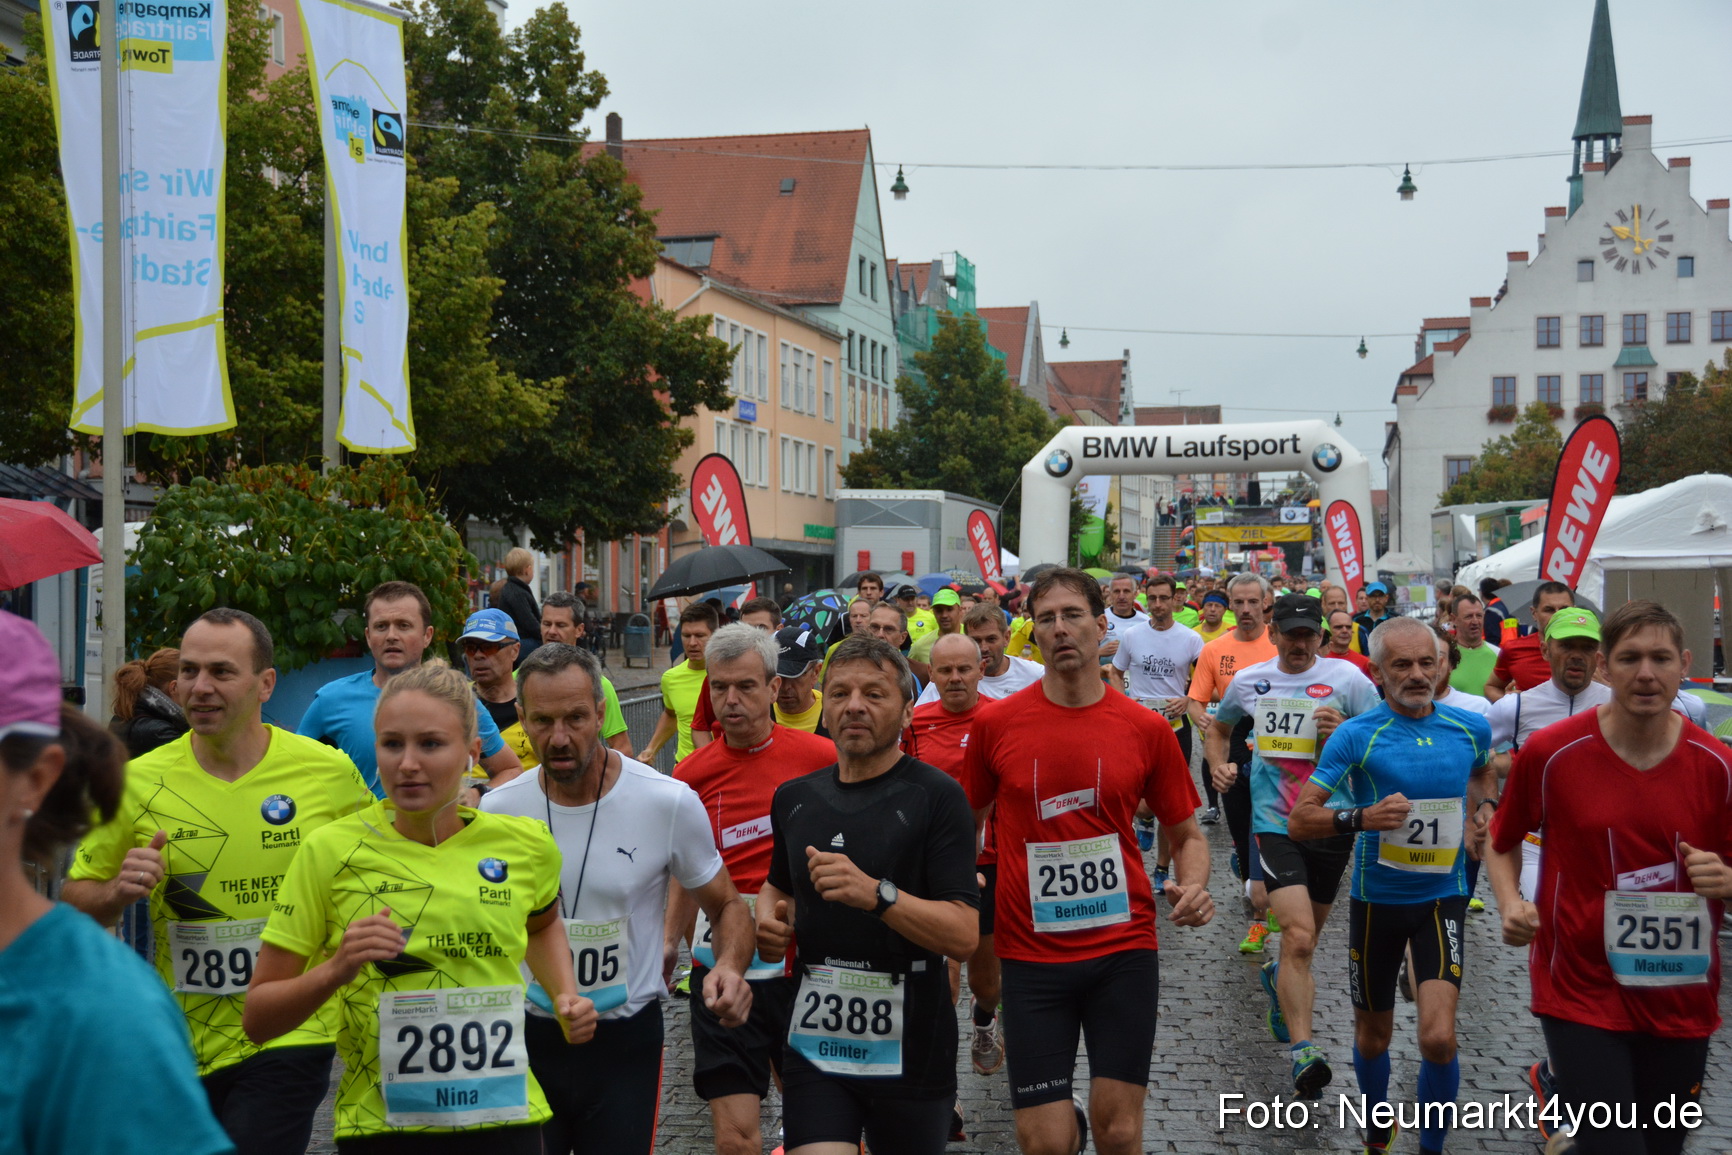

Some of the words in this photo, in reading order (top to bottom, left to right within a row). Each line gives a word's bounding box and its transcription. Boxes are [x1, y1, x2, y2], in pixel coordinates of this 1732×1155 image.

[1083, 436, 1158, 458] BMW
[1166, 433, 1301, 461] Laufsport
[1547, 440, 1610, 583] REWE
[1241, 529, 1267, 539] ZIEL
[1265, 711, 1305, 735] 347
[1272, 739, 1293, 751] Sepp
[1056, 796, 1080, 809] DEHN
[1420, 801, 1457, 812] BOCK
[261, 827, 300, 843] Partl
[736, 824, 759, 839] DEHN
[1407, 818, 1439, 845] 21
[262, 840, 301, 850] Neumarkt
[1067, 838, 1112, 855] BOCK
[1409, 851, 1435, 863] Willi
[1039, 857, 1118, 897] 2588
[1634, 871, 1660, 885] DEHN
[220, 879, 248, 892] THE
[479, 886, 511, 900] Partl
[234, 891, 259, 904] 100
[1055, 901, 1107, 919] Berthold
[569, 921, 619, 938] BOCK
[1616, 914, 1700, 951] 2551
[426, 933, 455, 948] THE
[458, 932, 493, 945] NEXT
[442, 947, 467, 958] 100
[182, 947, 259, 988] 289
[570, 944, 619, 986] 05
[825, 956, 864, 969] Continental
[1634, 959, 1683, 973] Markus
[840, 971, 893, 989] BOCK
[447, 990, 512, 1010] BOCK
[392, 1005, 438, 1015] NeuerMarkt
[800, 990, 892, 1035] 2388
[397, 1019, 515, 1075] 2892
[818, 1041, 868, 1060] Günter
[388, 1072, 394, 1081] D
[436, 1088, 479, 1107] Nina
